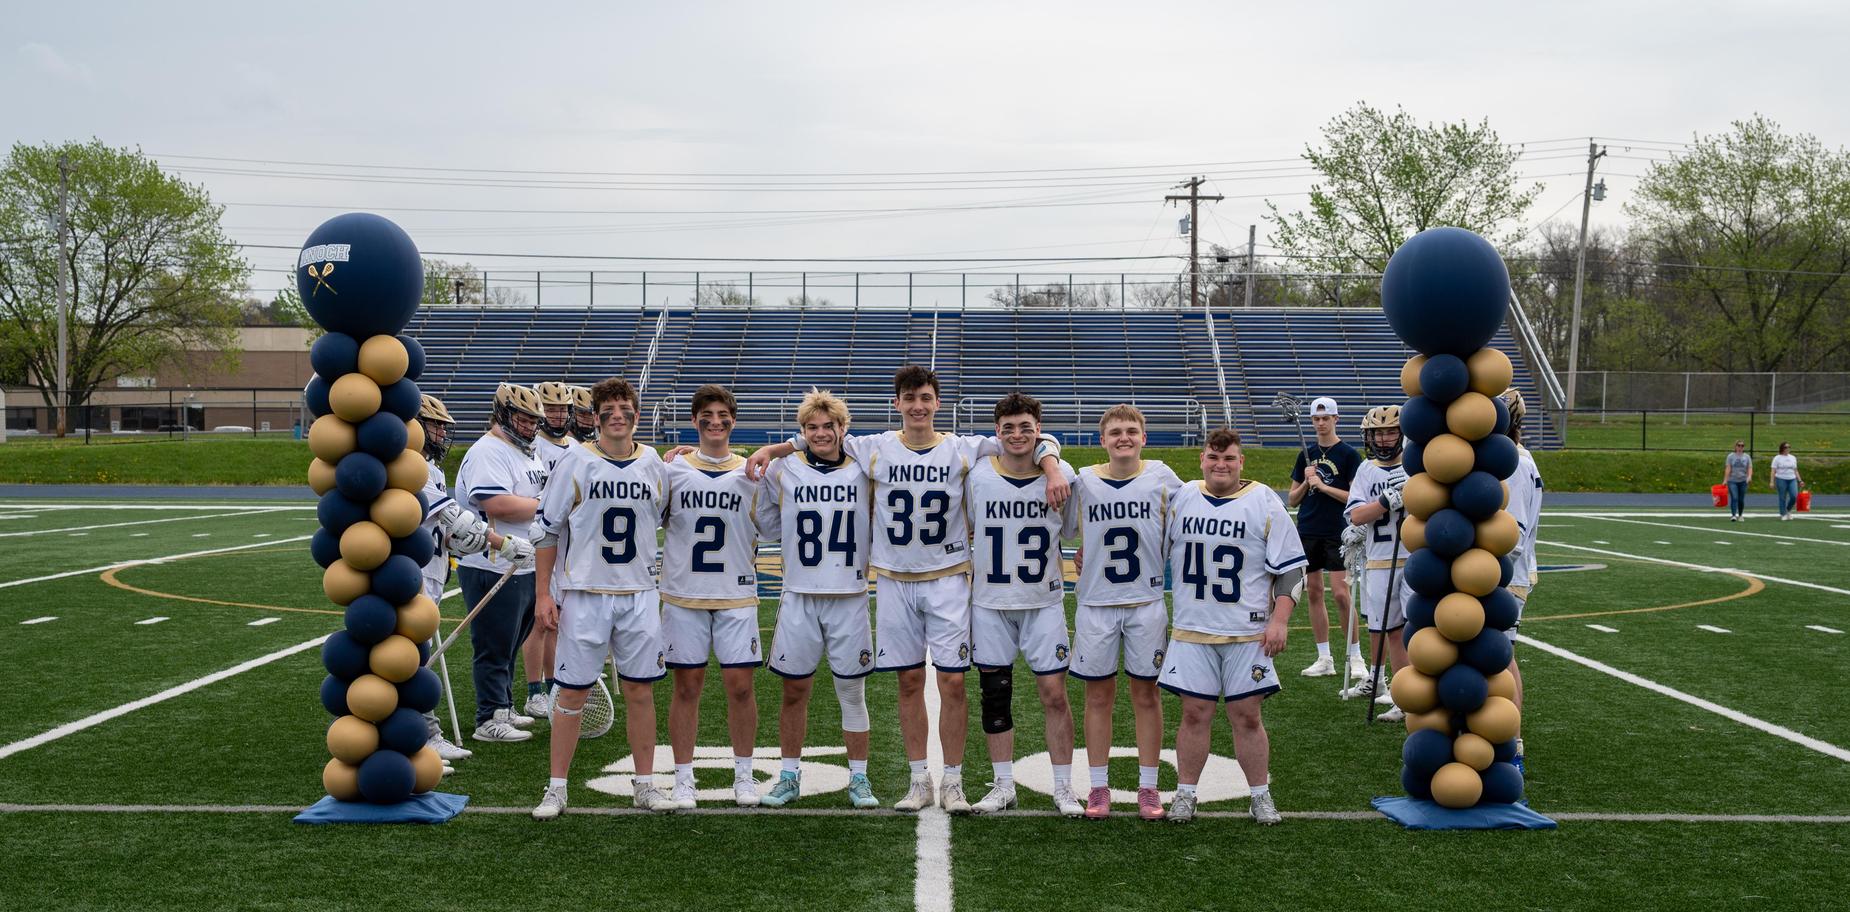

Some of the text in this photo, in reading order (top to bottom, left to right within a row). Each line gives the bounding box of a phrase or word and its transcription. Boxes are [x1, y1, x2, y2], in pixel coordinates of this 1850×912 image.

[589, 480, 652, 500] KNOCH
[888, 464, 950, 483] KNOCH
[680, 490, 742, 512] KNOCH
[794, 485, 857, 503] KNOCH
[985, 500, 1049, 519] KNOCH
[1088, 501, 1151, 523] KNOCH
[601, 506, 637, 565] 9
[886, 489, 951, 546] 33
[1182, 516, 1246, 539] KNOCH
[692, 516, 726, 573] 2
[796, 510, 857, 567] 84
[985, 526, 1050, 584] 13
[1103, 526, 1141, 584] 3
[1182, 541, 1244, 604] 43
